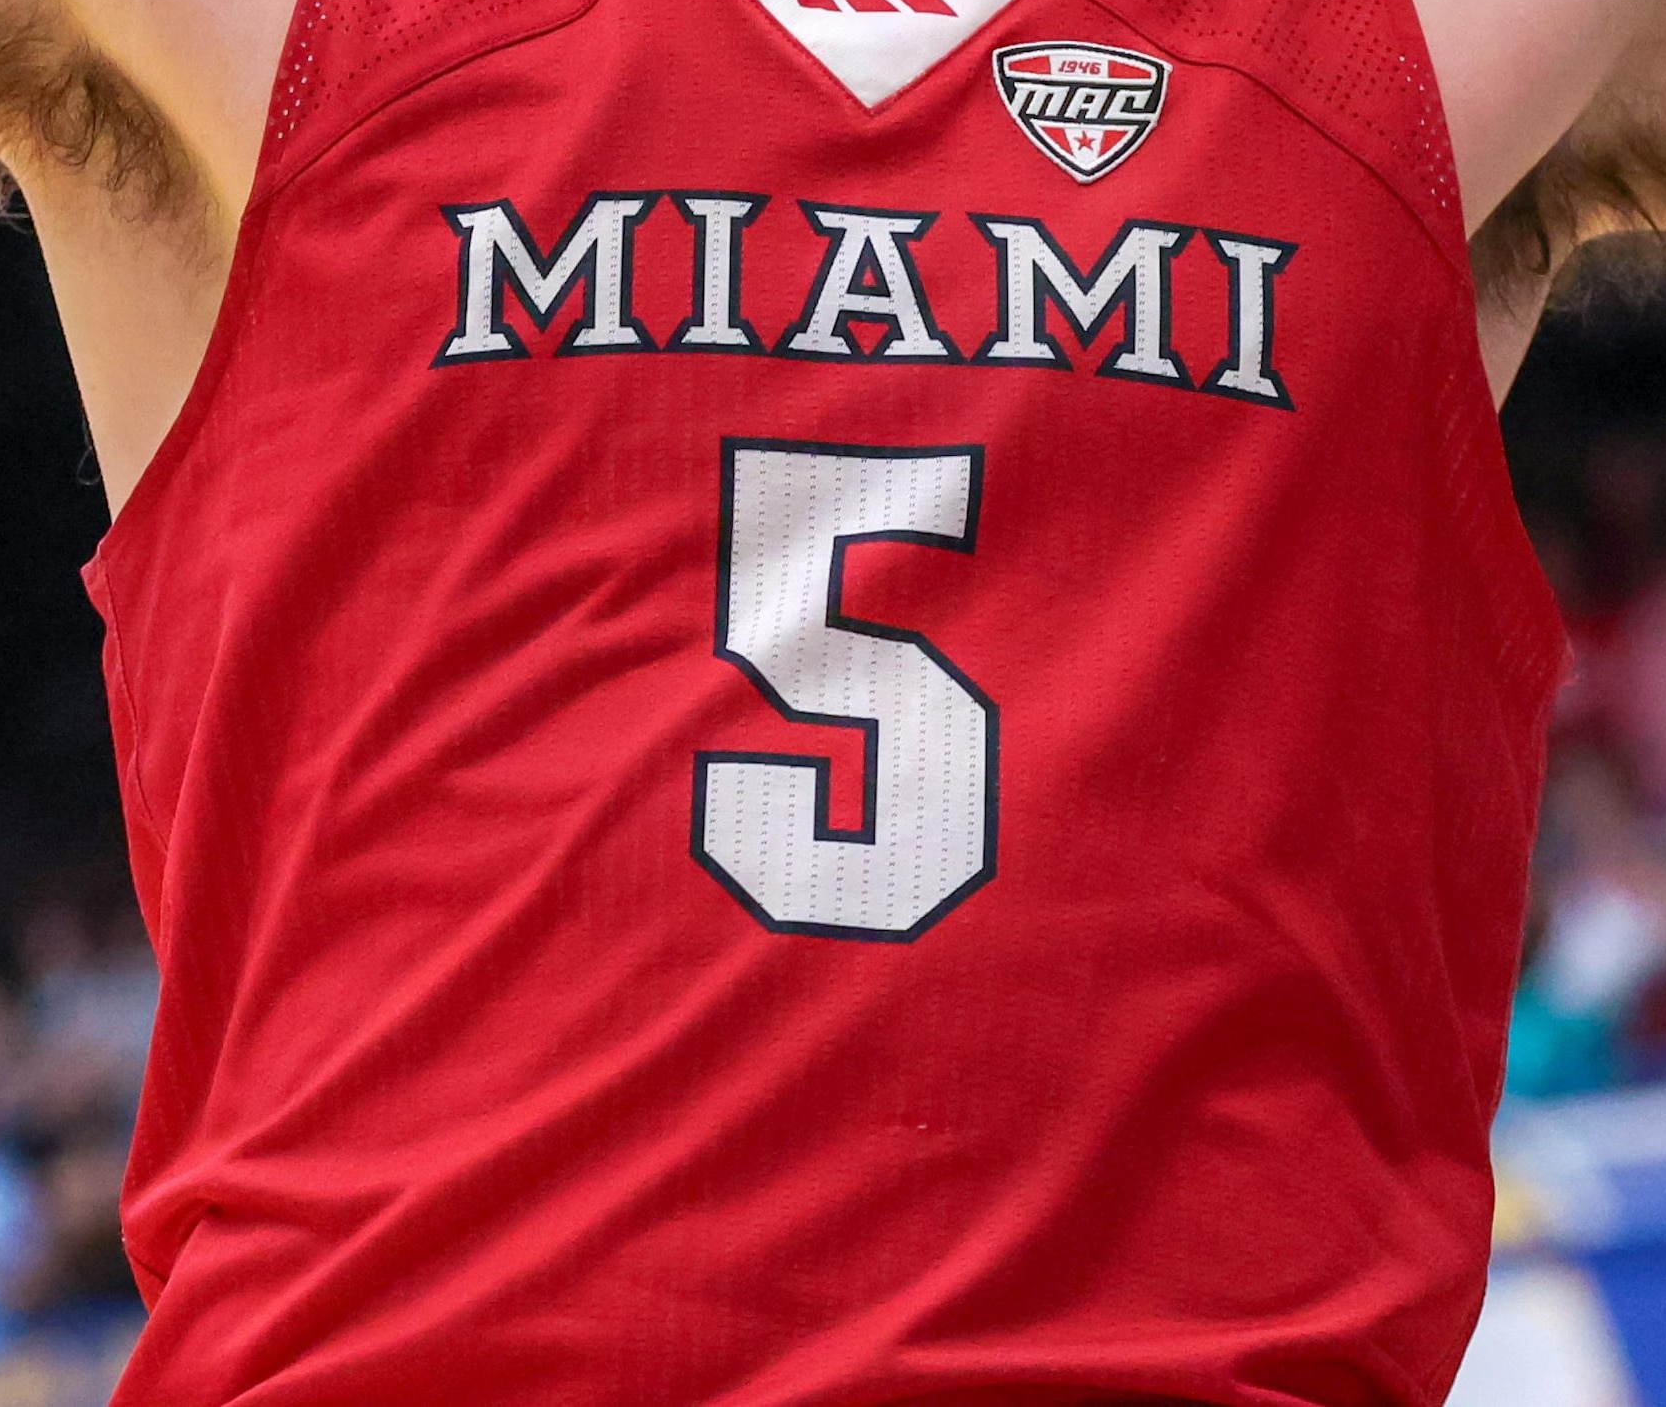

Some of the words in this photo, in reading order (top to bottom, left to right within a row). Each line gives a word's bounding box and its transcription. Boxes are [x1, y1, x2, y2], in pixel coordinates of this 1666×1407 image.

[1010, 82, 1159, 121] MAC
[1057, 59, 1102, 75] 1946
[427, 190, 1298, 412] MIAMI
[690, 436, 1000, 944] 5
